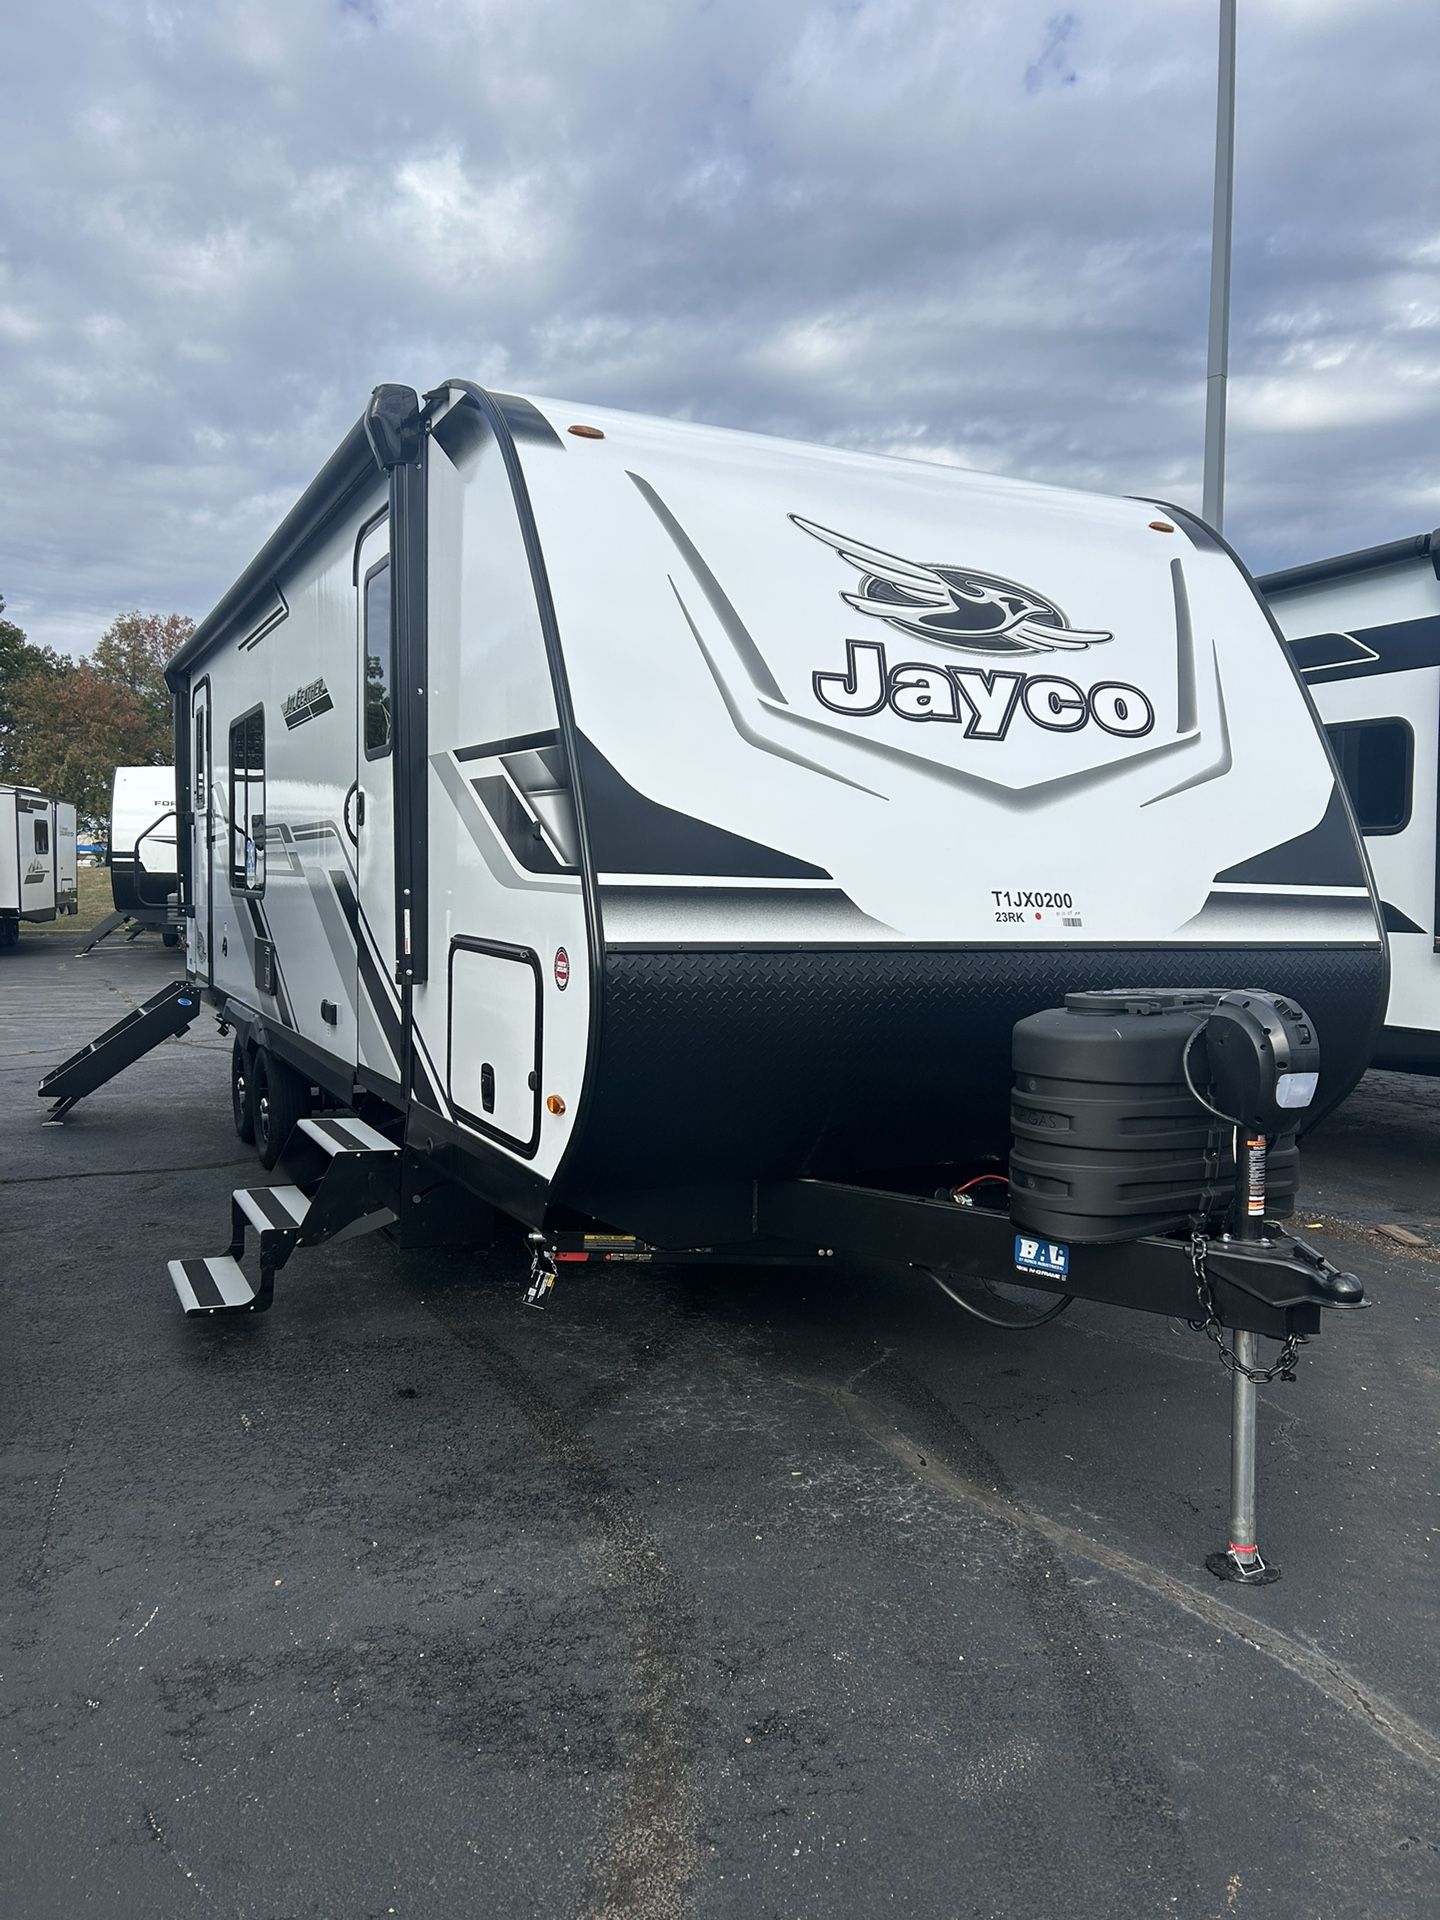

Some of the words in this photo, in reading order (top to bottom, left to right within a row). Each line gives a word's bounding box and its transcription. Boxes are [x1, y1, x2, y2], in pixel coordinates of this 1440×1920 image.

[812, 638, 1155, 741] Jayco
[991, 890, 1073, 909] T1JX0200
[994, 911, 1025, 923] 23RK
